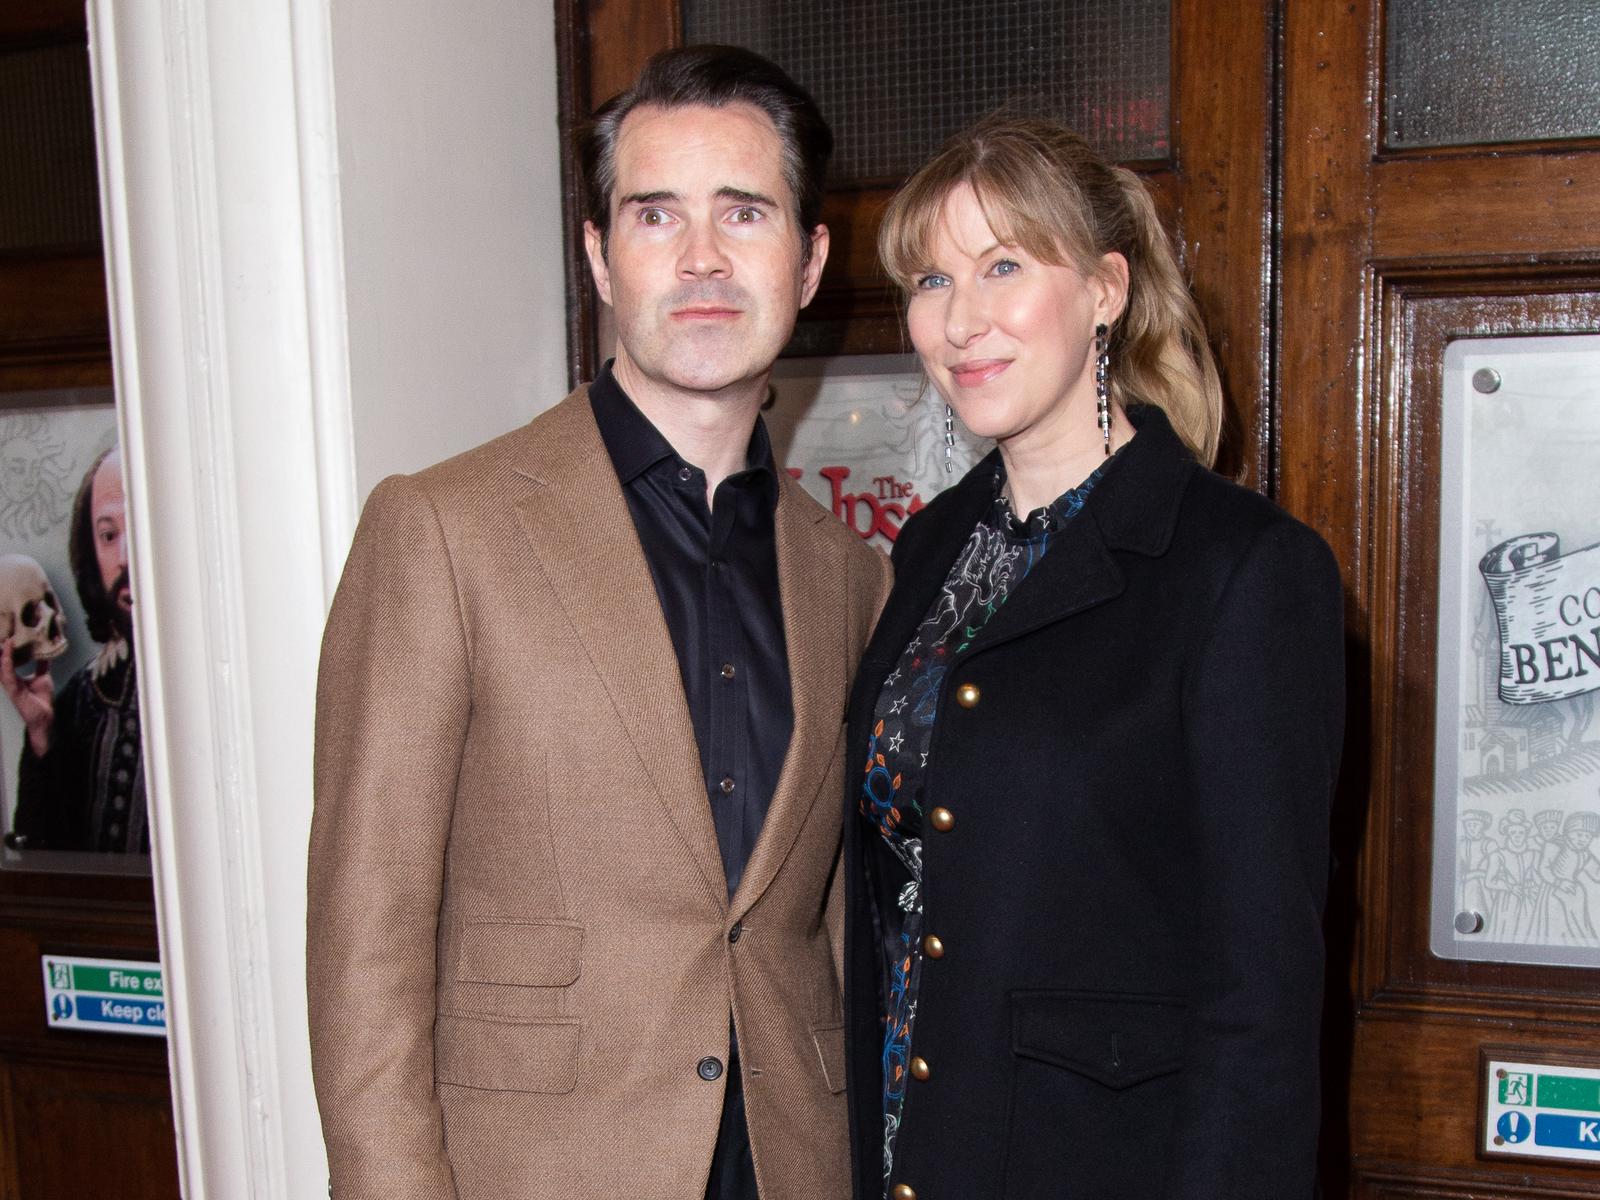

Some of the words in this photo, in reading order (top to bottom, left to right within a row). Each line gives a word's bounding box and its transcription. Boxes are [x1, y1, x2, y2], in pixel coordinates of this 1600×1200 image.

[873, 474, 914, 500] The
[1509, 626, 1600, 685] BEN
[109, 971, 141, 989] Fire
[100, 1000, 144, 1022] Keep
